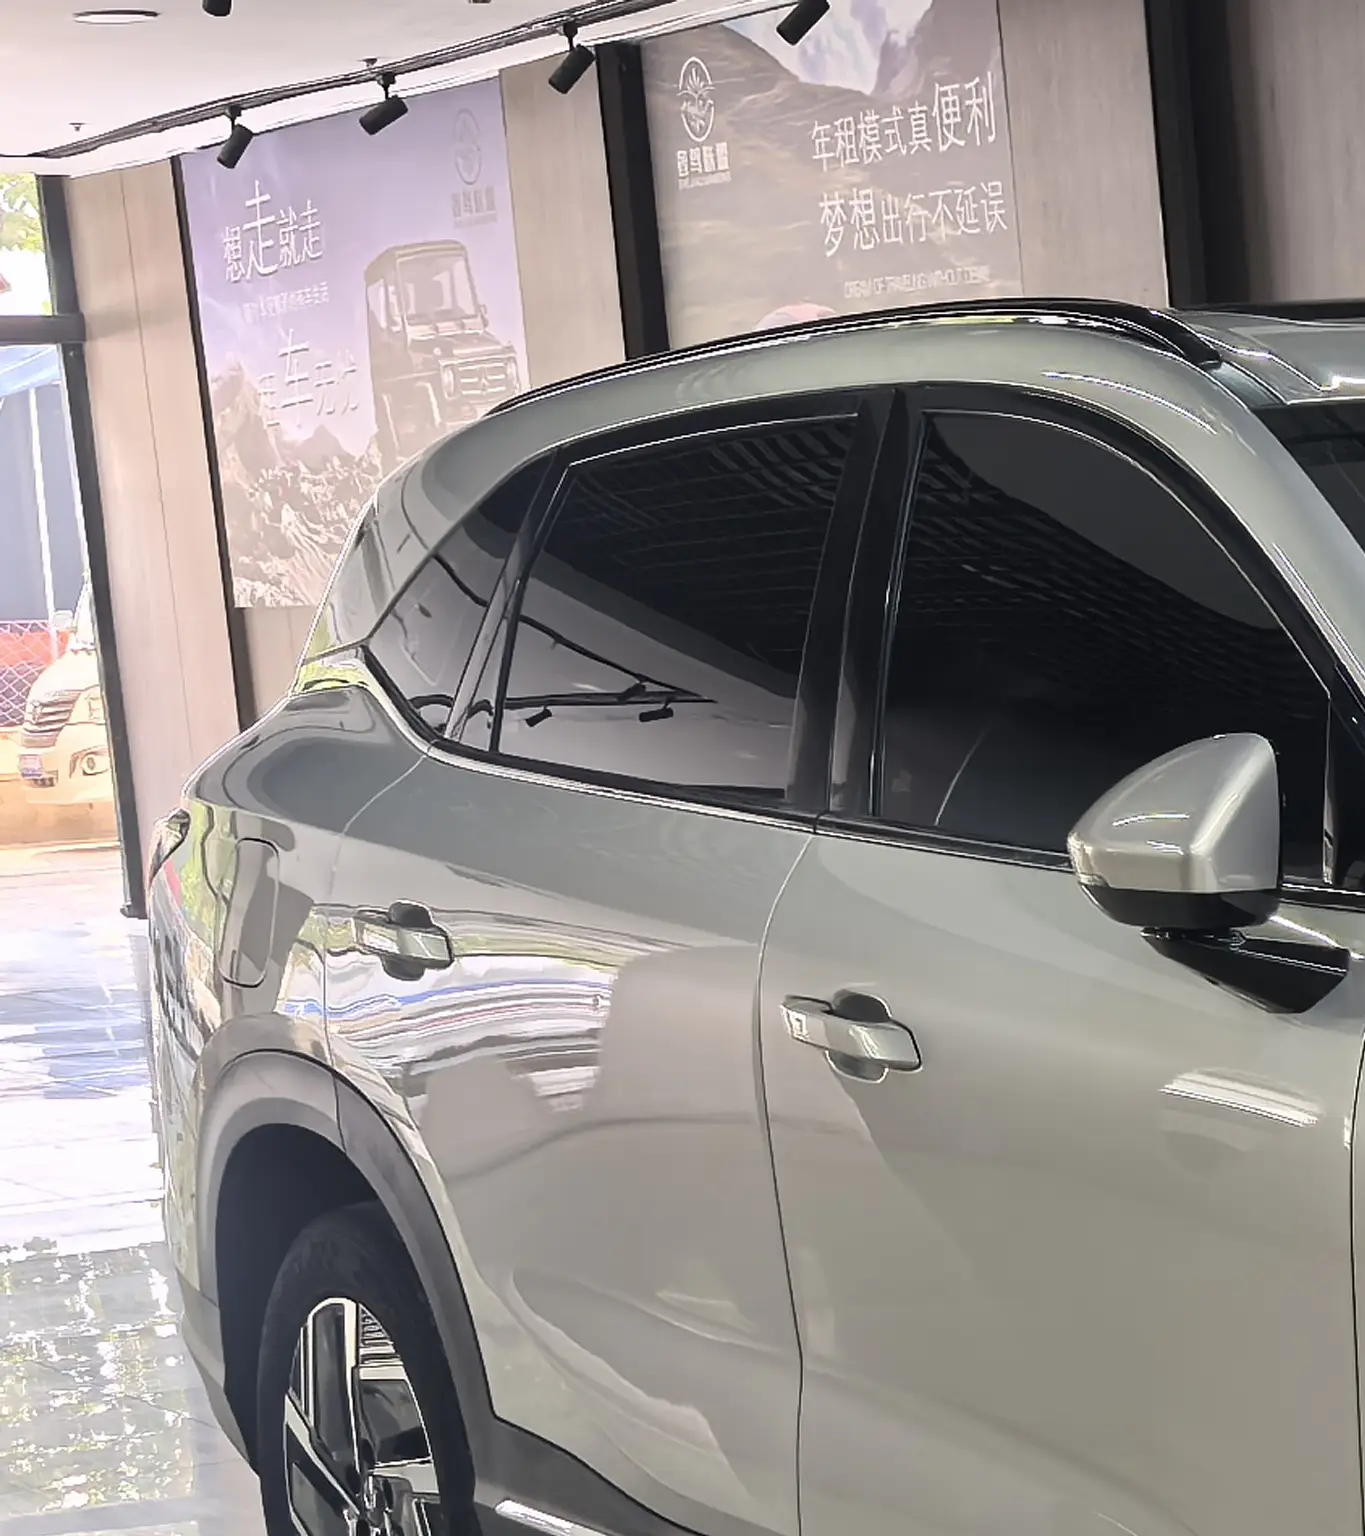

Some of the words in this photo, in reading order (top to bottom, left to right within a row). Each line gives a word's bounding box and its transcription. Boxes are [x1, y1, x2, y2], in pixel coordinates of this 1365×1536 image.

[811, 70, 997, 173] 年租模式真便利
[222, 179, 324, 283] 想走就走
[819, 181, 1008, 258] 梦想出行不延误
